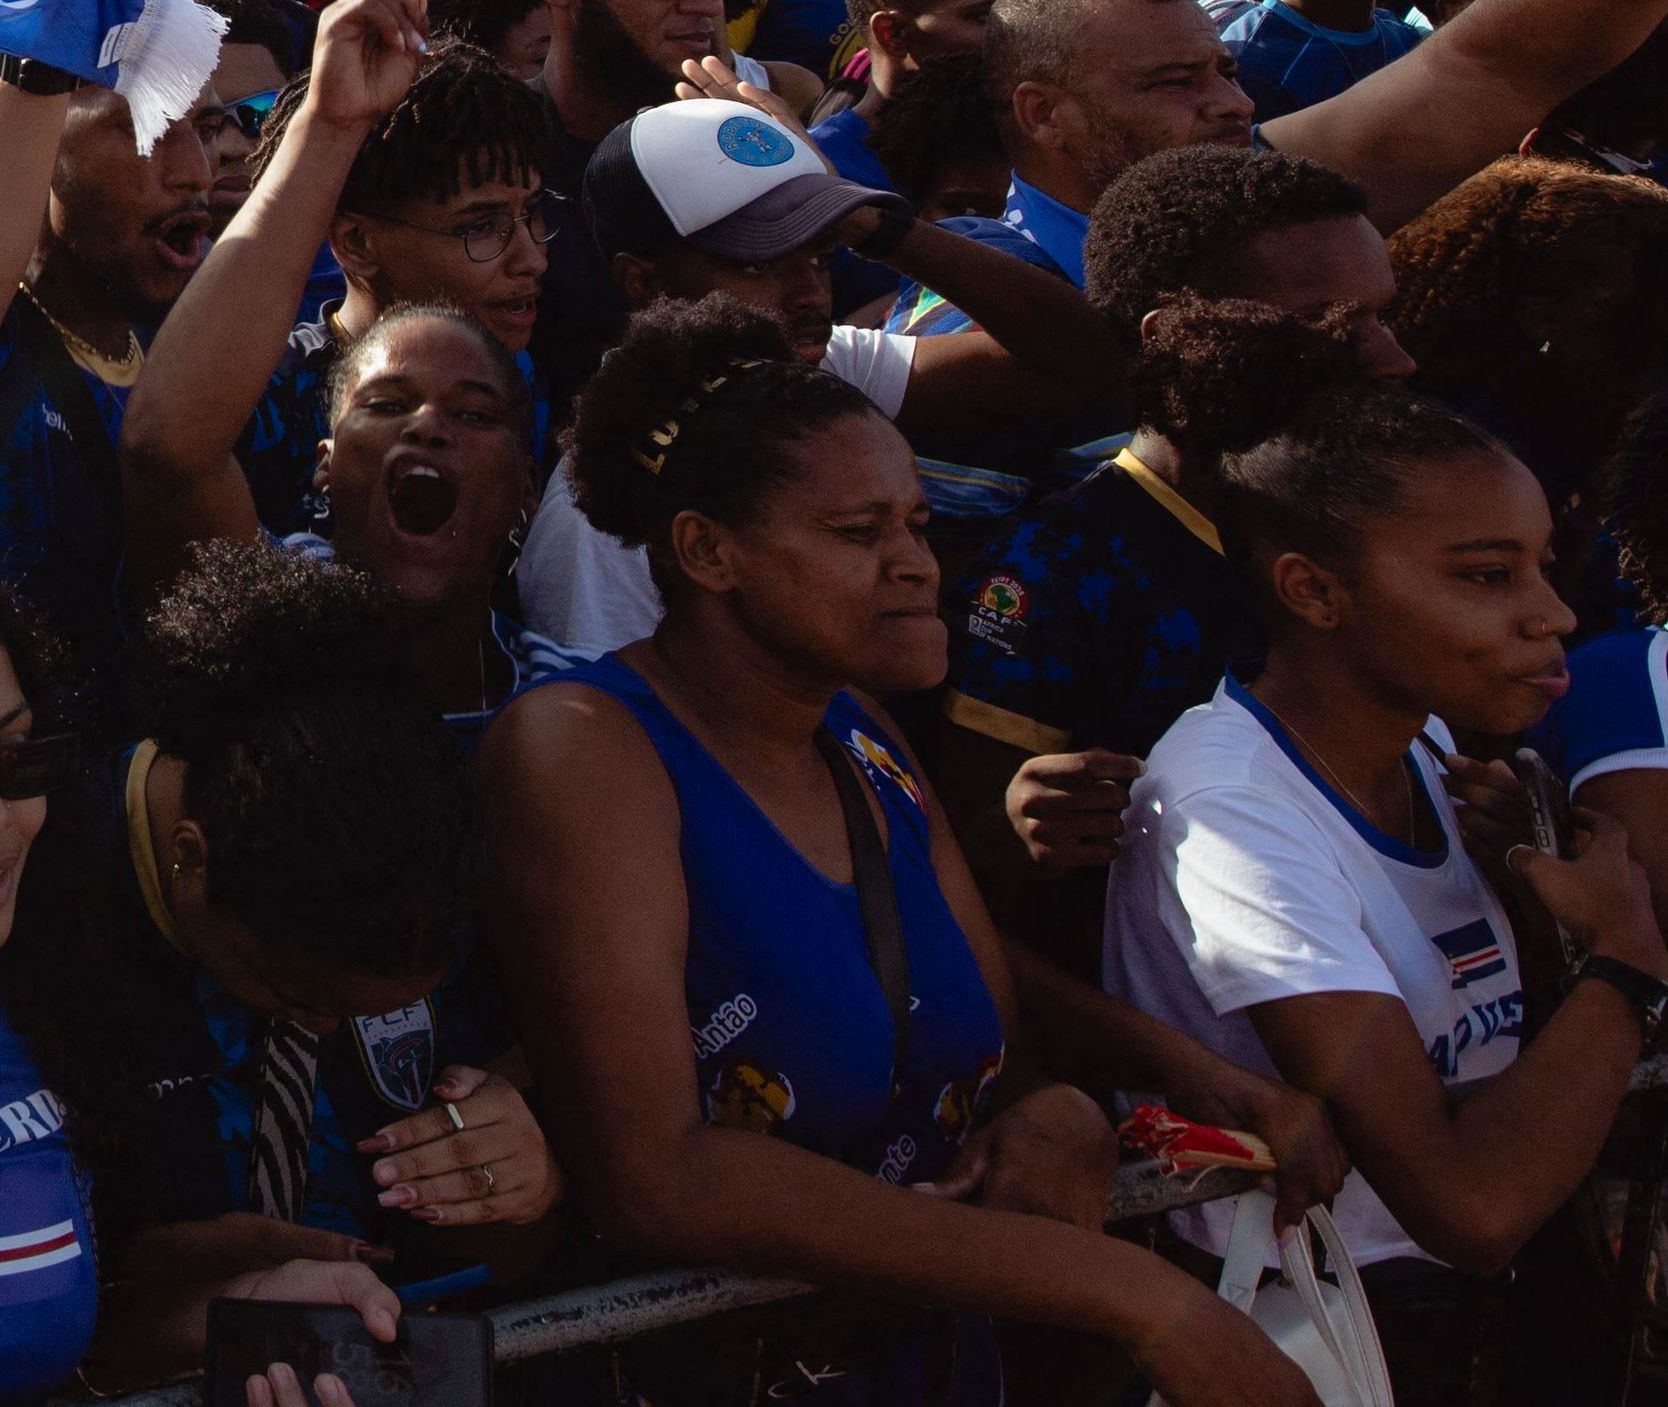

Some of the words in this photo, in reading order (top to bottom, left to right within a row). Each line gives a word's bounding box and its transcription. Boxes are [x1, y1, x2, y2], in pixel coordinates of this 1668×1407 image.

[978, 606, 1012, 625] CAF
[691, 992, 758, 1059] Antão
[1471, 990, 1523, 1046] VE
